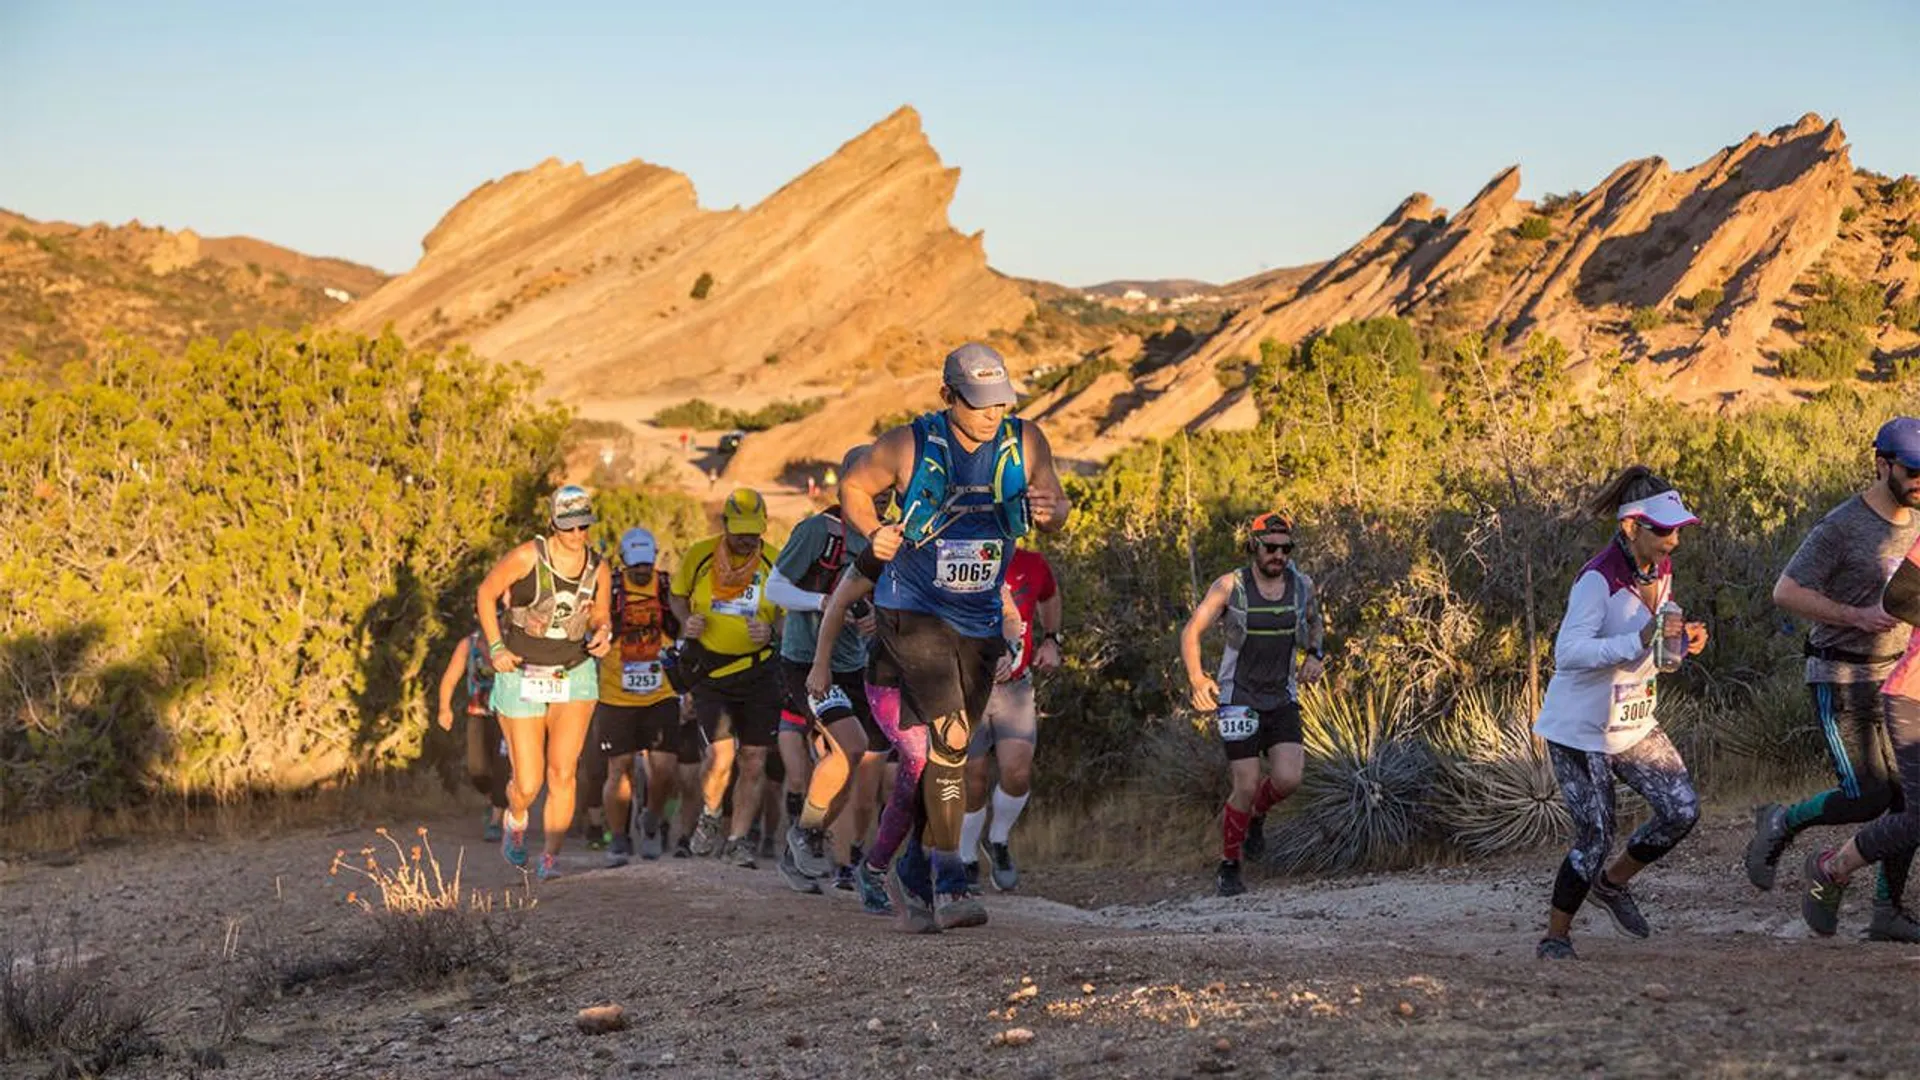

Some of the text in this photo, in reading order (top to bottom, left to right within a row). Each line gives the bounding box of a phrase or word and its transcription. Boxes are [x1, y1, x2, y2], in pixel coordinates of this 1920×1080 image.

[946, 562, 992, 582] 3065
[628, 674, 657, 687] 3253
[1620, 699, 1652, 721] 3007
[1222, 720, 1253, 733] 3145
